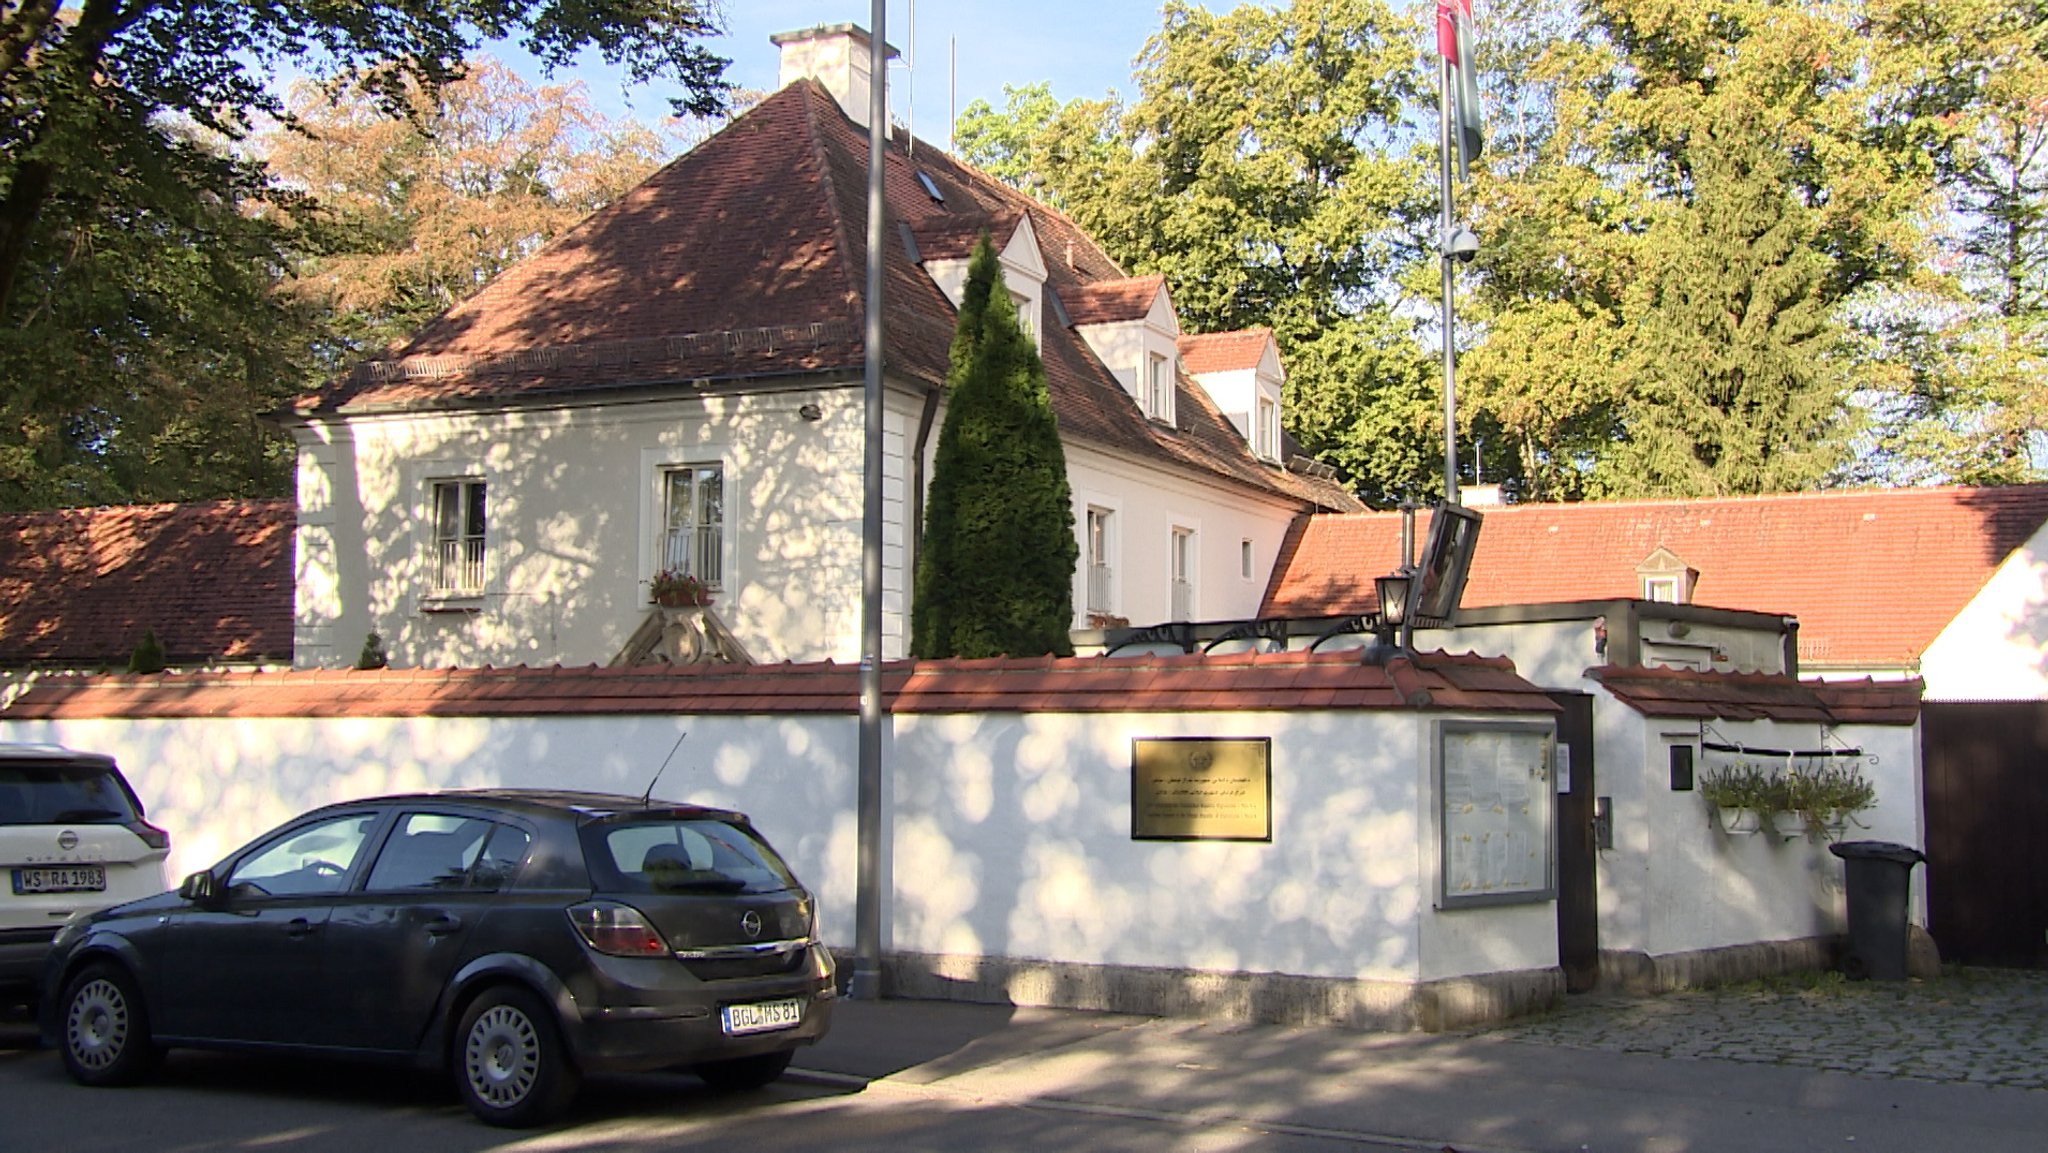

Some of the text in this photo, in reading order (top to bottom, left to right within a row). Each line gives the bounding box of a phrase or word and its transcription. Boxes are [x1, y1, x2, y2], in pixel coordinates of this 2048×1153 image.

[23, 869, 103, 887] WS RA 1983
[732, 1008, 758, 1027] BGL
[782, 1002, 797, 1020] 81
